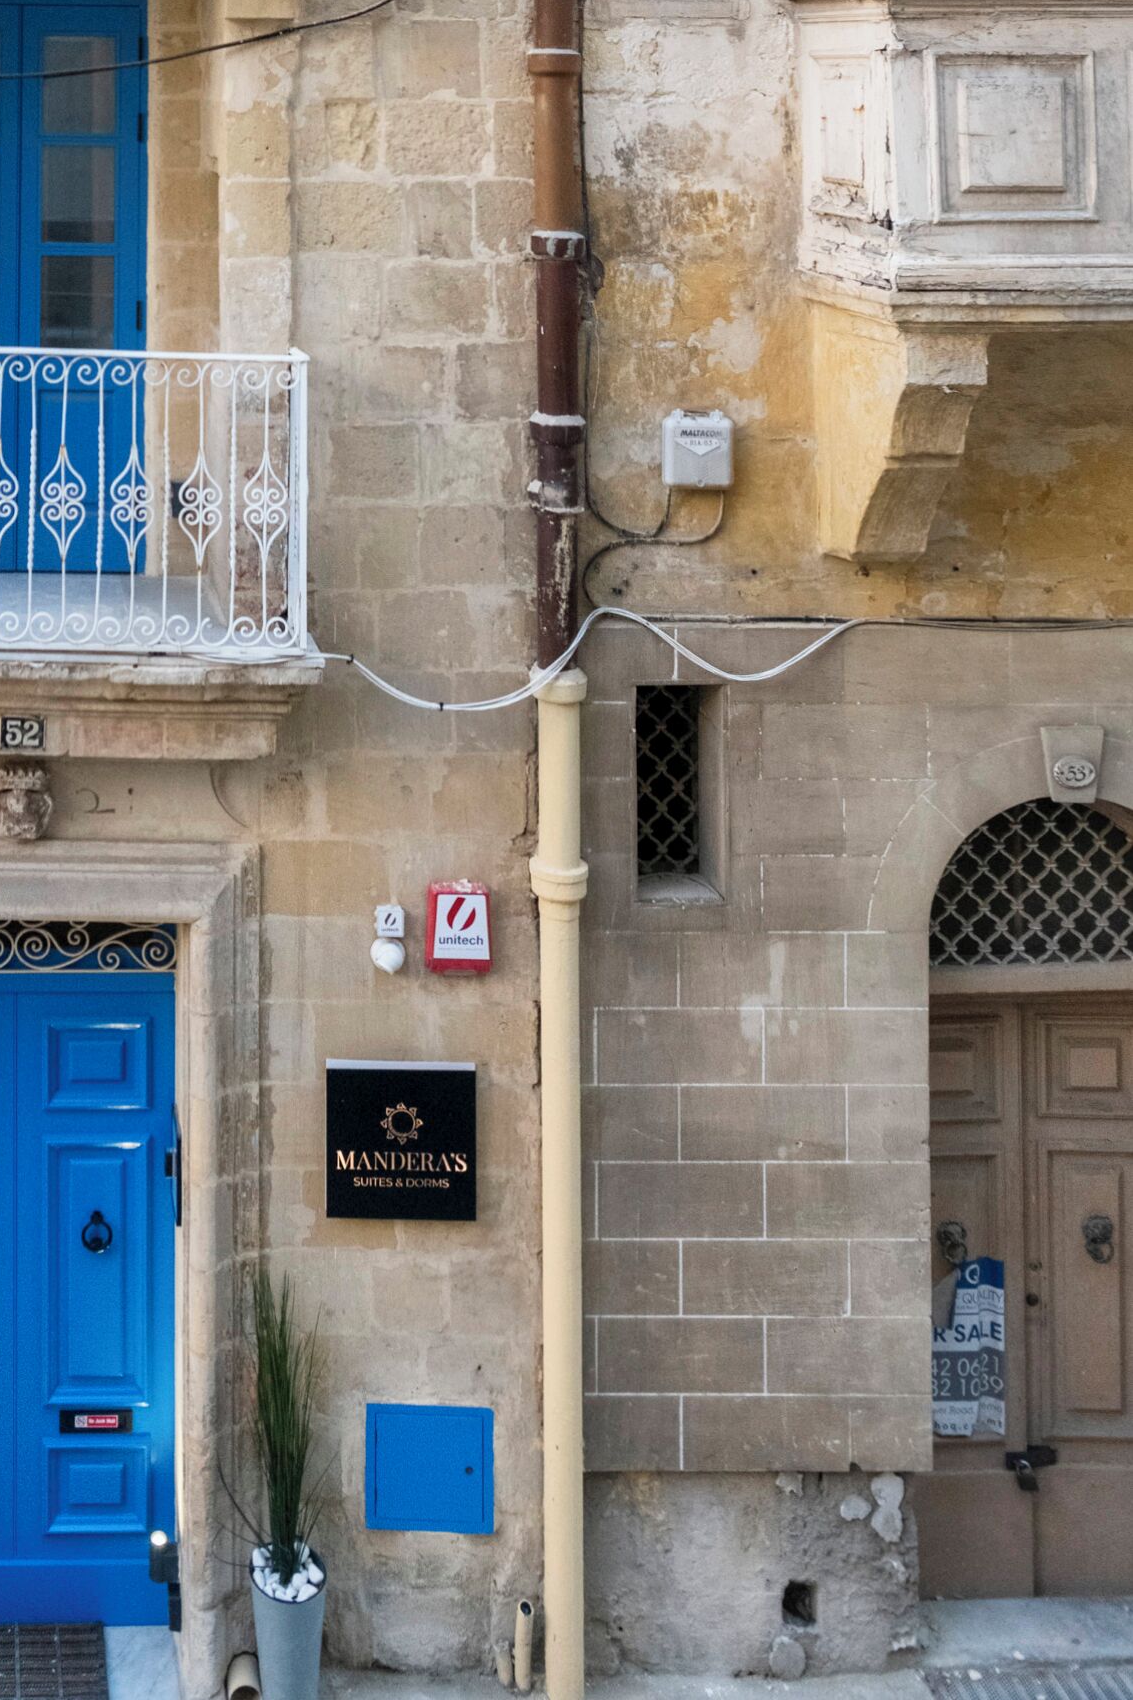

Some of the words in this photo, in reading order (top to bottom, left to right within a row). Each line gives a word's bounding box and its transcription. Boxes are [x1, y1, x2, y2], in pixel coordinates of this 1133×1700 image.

[680, 429, 723, 438] MALTACOM
[5, 720, 40, 746] 52
[1065, 765, 1086, 782] 53
[438, 934, 484, 946] unitech
[335, 1149, 468, 1173] MANDERA'S
[353, 1176, 393, 1188] SUITES
[395, 1178, 403, 1188] &
[405, 1178, 450, 1189] DORMS
[962, 1288, 1003, 1304] QUALITY
[954, 1320, 1003, 1343] SALE
[957, 1353, 1000, 1377] 0621
[959, 1373, 1004, 1397] 1039
